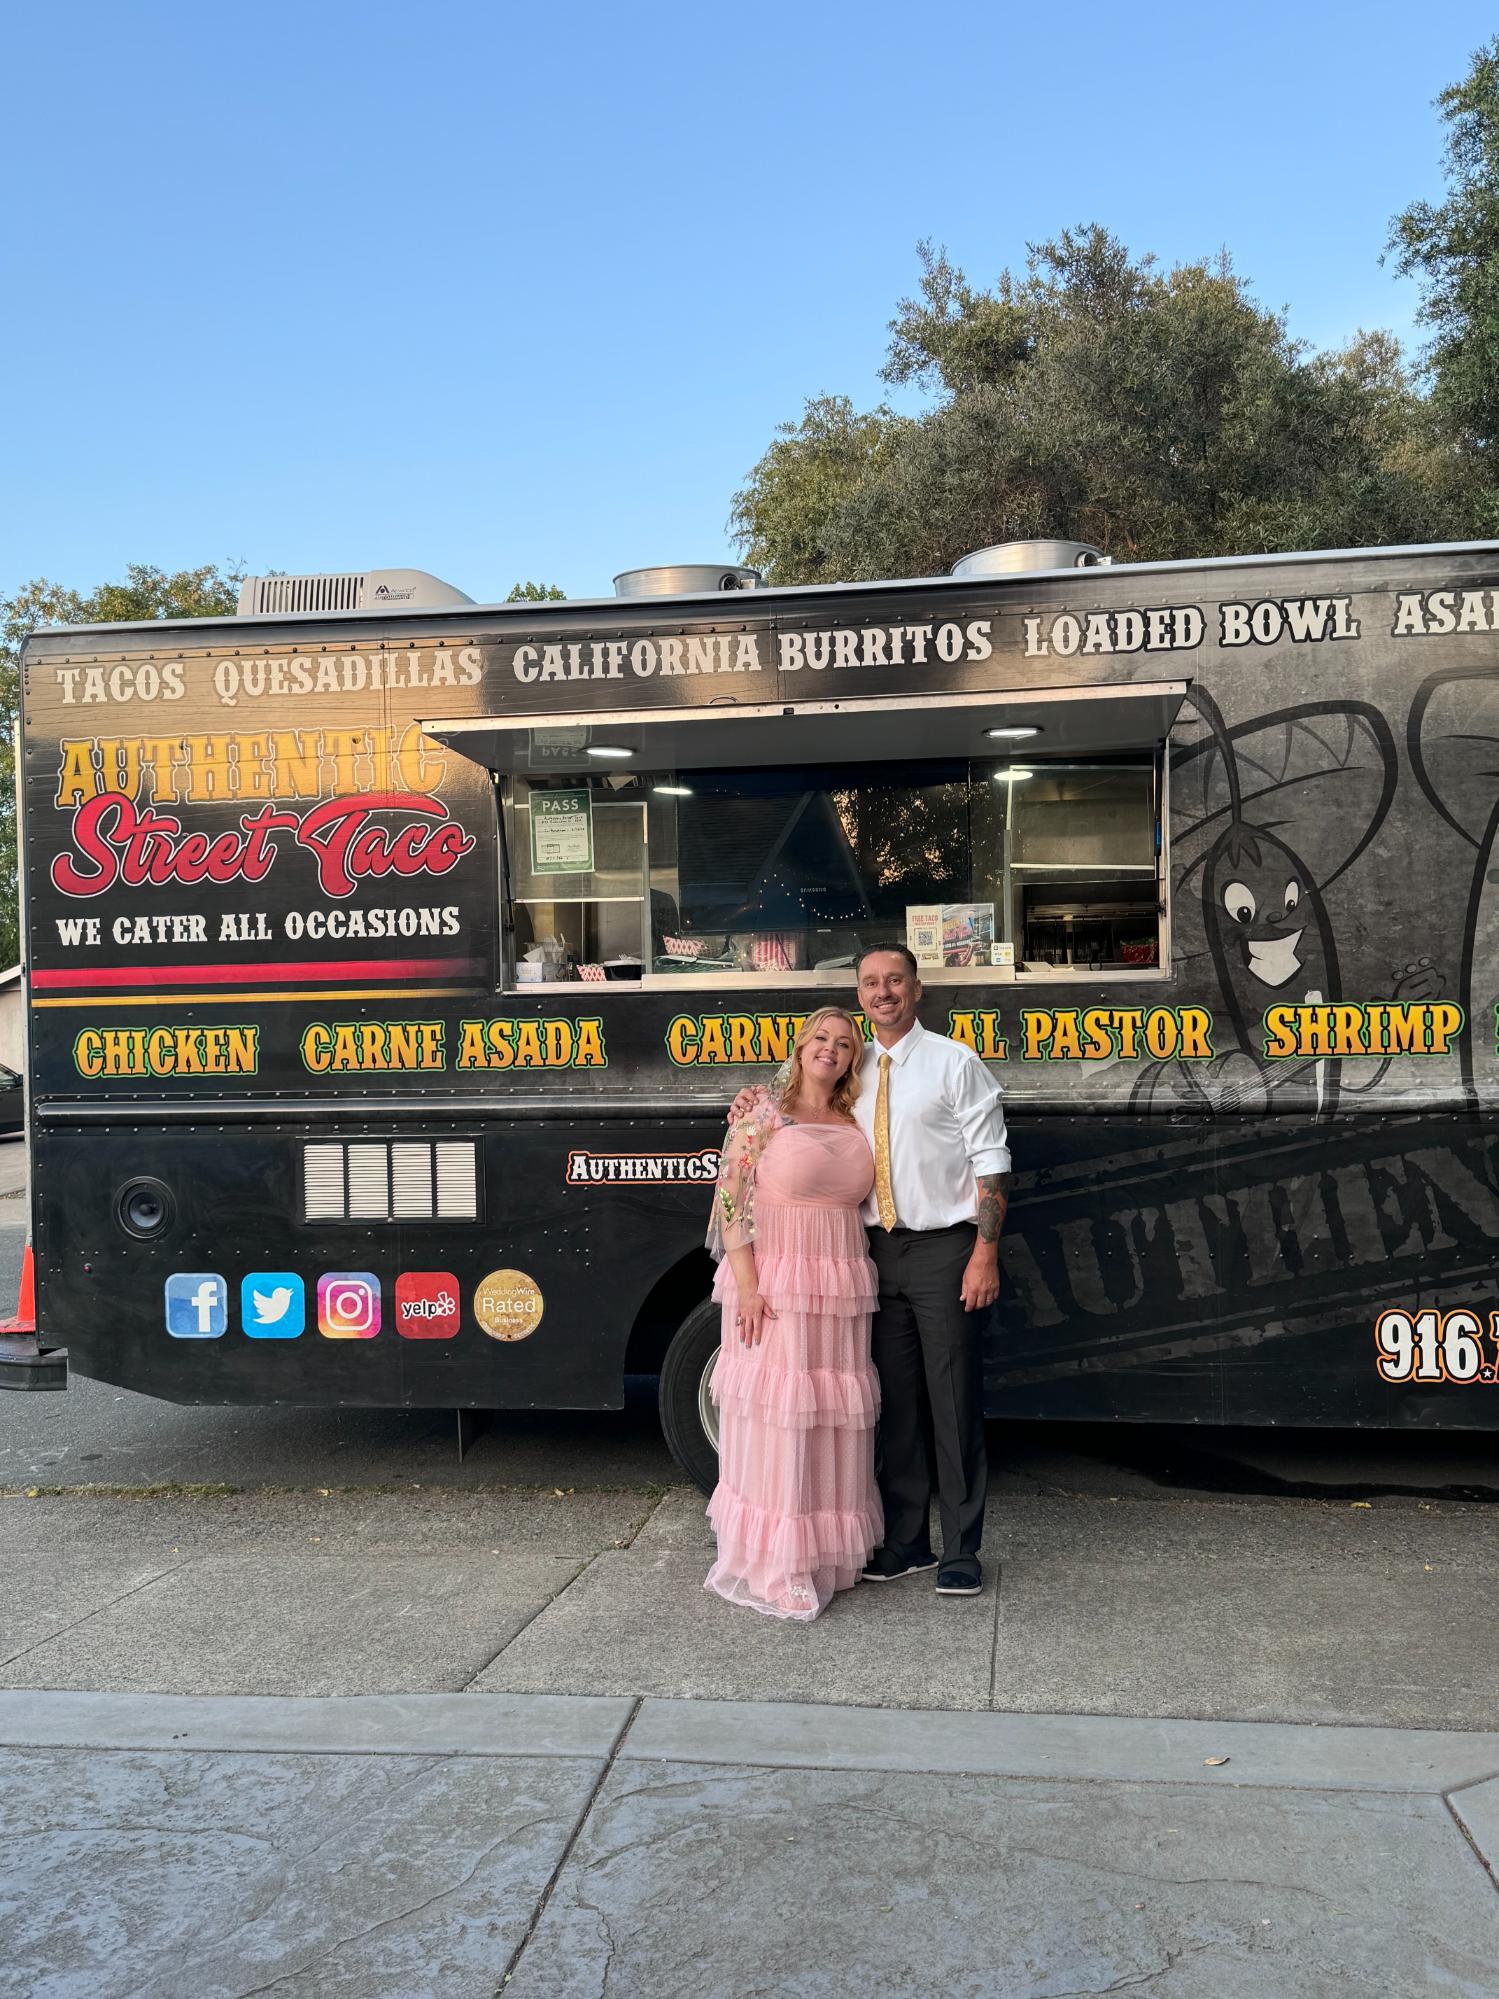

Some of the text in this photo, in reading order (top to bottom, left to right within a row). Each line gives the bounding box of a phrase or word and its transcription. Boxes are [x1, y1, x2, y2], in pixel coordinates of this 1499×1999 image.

[1023, 595, 1361, 658] LOADED BOWL
[1393, 589, 1499, 636] ASA
[213, 648, 482, 706] QUESADILLAS
[512, 621, 992, 683] CALIFORNIA BURRITOS
[56, 662, 186, 704] TACOS
[55, 723, 449, 808] AUTHENTIC
[542, 799, 579, 812] PASS
[51, 791, 298, 898] Street
[297, 793, 475, 898] Taco
[55, 906, 460, 946] WE CATER ALL OCCASIONS
[73, 1025, 260, 1078] CHICKEN
[300, 1017, 608, 1073] CARNE ASADA
[947, 1005, 1216, 1062] AL PASTOR
[1263, 1000, 1465, 1060] SHRIMP
[568, 1151, 721, 1182] AUTHENTICS
[402, 1299, 438, 1318] yelp
[482, 1297, 536, 1312] Rated
[483, 1287, 535, 1297] WeddingWire
[494, 1316, 523, 1324] Business
[1375, 1309, 1499, 1385] 916
